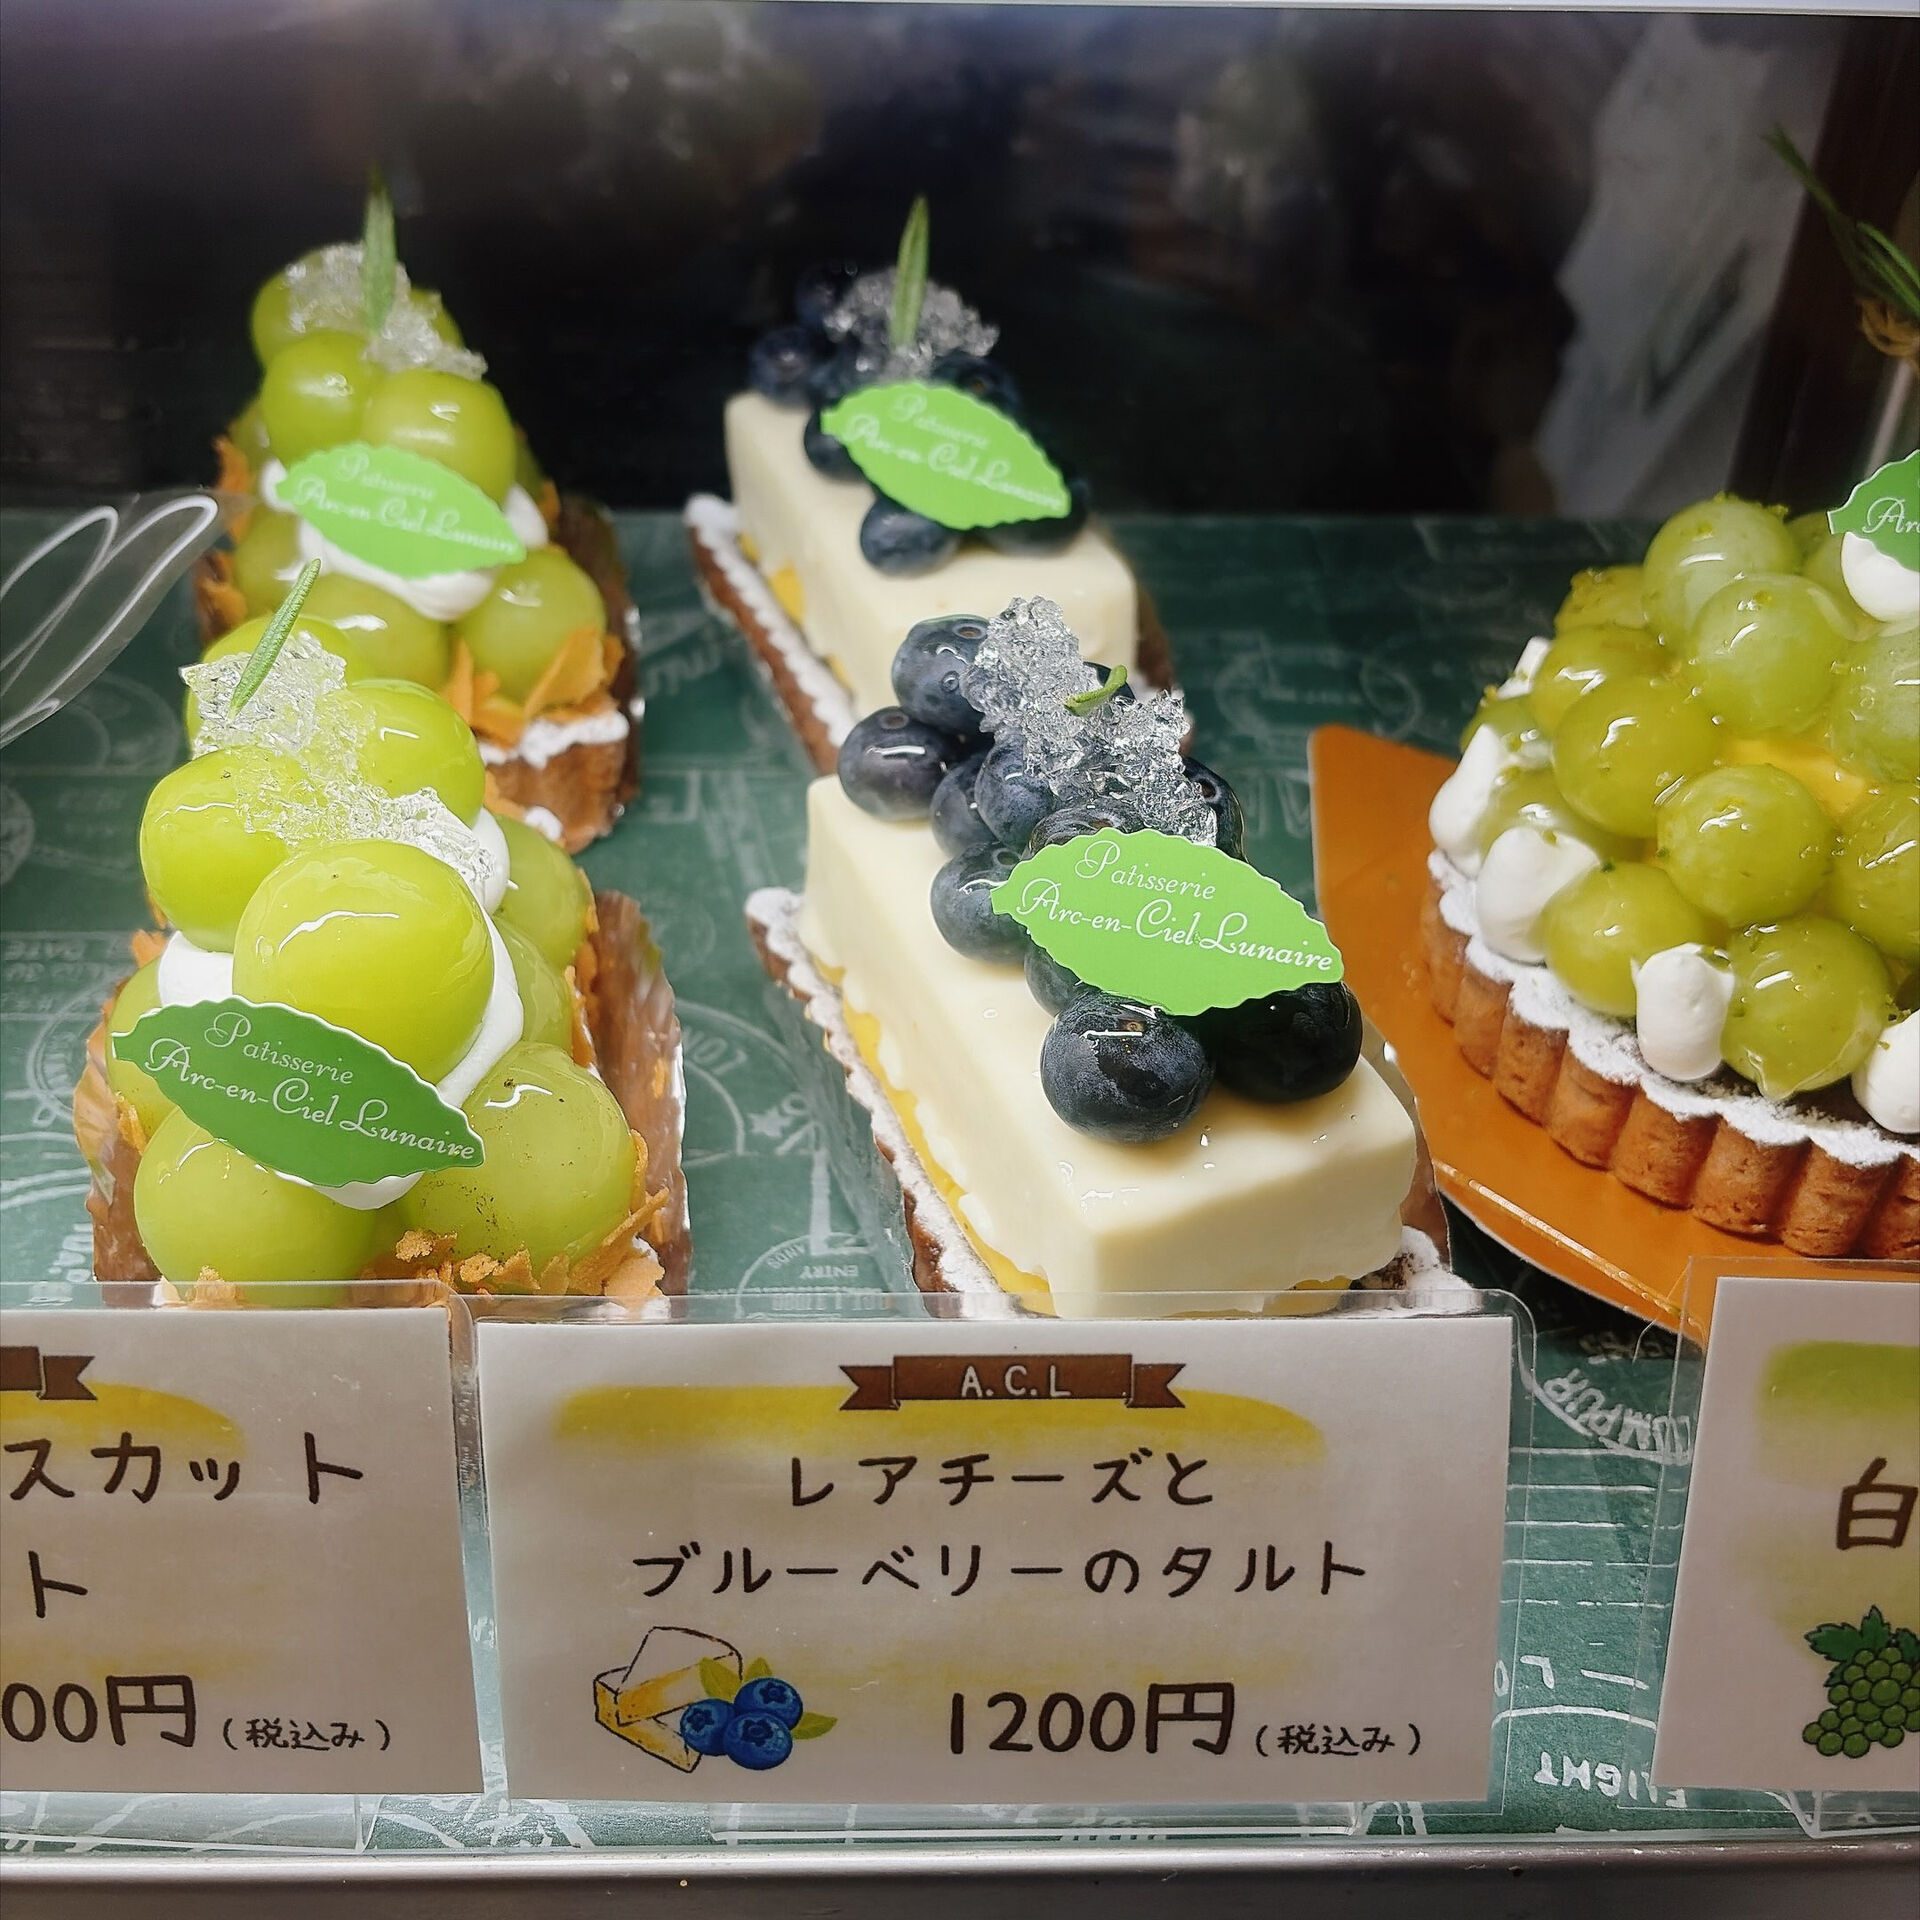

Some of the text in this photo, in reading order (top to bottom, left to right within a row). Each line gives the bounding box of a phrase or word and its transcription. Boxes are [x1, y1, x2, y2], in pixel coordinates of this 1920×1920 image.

[1075, 840, 1216, 900] Patisserie
[1199, 912, 1332, 971] Lunaire
[204, 1011, 353, 1085] Patisserie
[339, 1099, 475, 1160] Lunaire
[799, 1264, 859, 1280] ENTRY
[4, 1431, 363, 1503] スカット
[791, 1447, 1214, 1506] レアチーズと
[1836, 1457, 1919, 1551] 白
[28, 1551, 88, 1618] ト
[633, 1540, 1366, 1598] ブルーベリーのタルト
[1, 1675, 391, 1751] 00円 (税込み)
[950, 1682, 1421, 1758] 1200円 (税込み)
